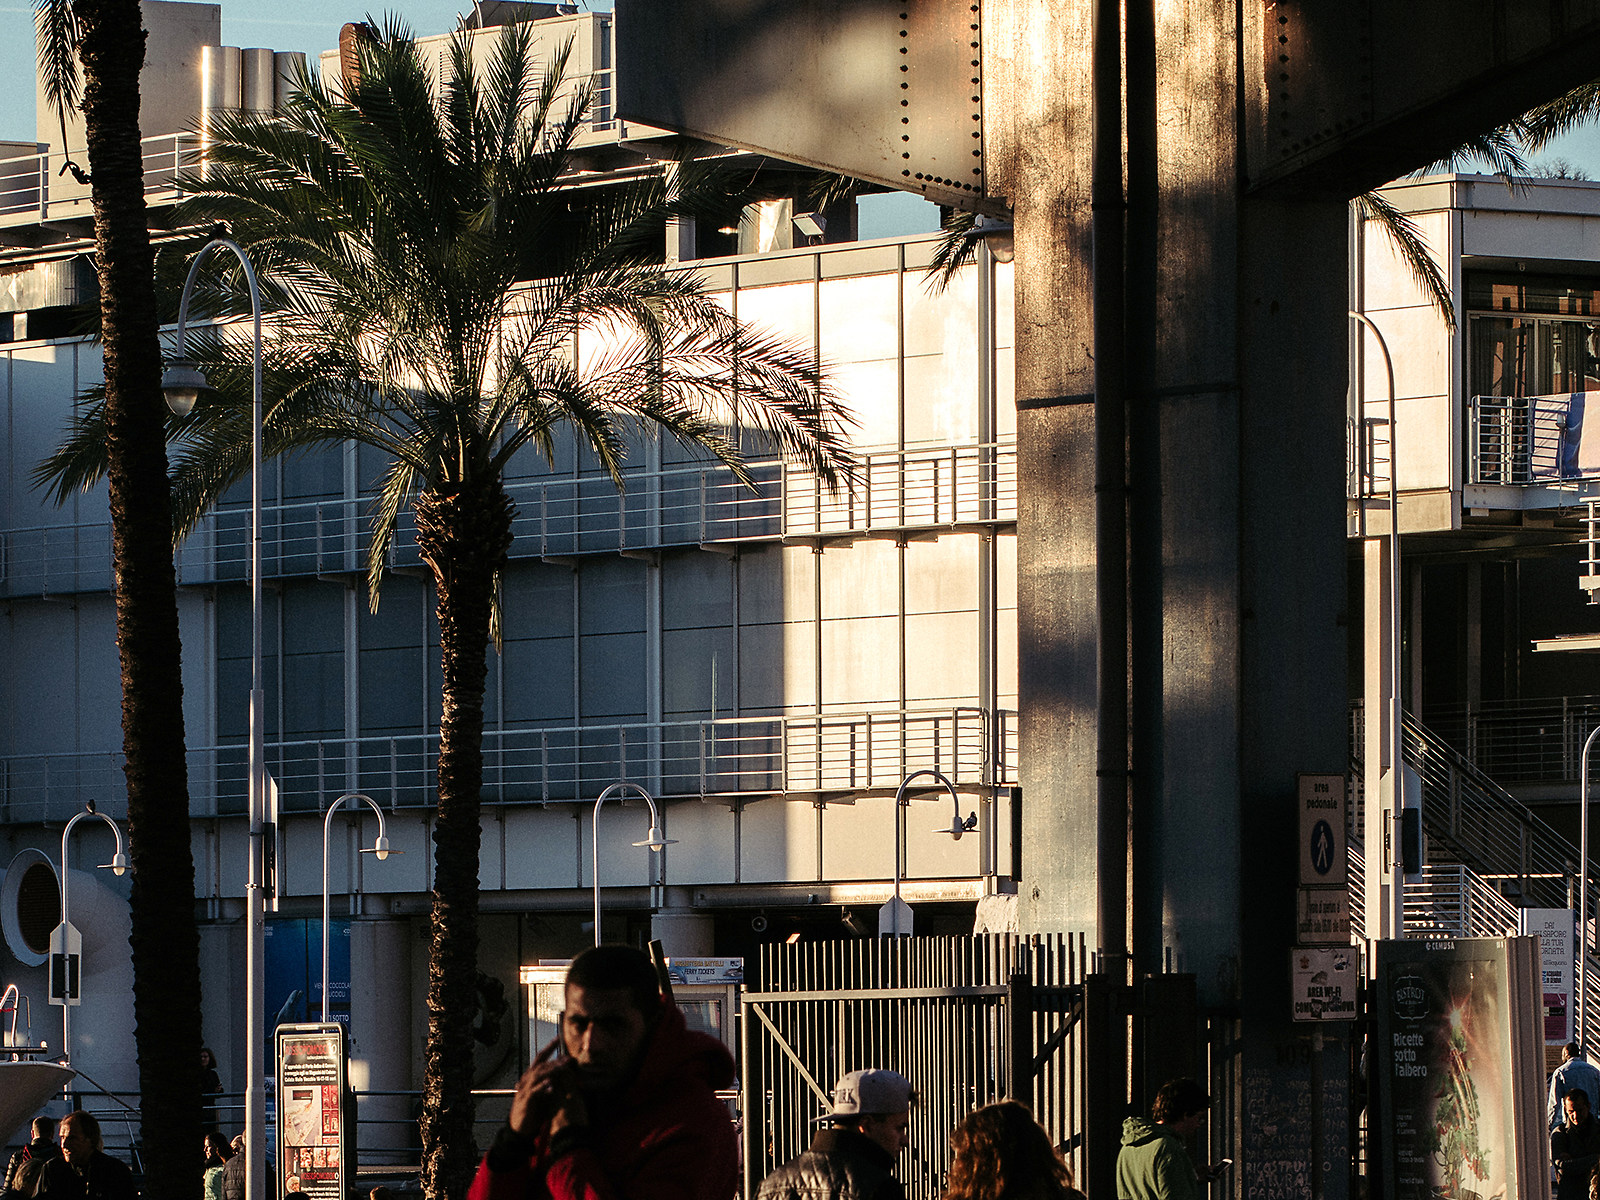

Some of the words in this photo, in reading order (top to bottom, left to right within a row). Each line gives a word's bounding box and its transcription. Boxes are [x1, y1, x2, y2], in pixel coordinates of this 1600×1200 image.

[1314, 783, 1329, 793] area
[1306, 796, 1338, 809] pedonale
[1543, 930, 1567, 938] SAPORE
[1551, 938, 1564, 946] TUA
[1541, 947, 1565, 955] ORNATA
[1307, 986, 1323, 997] AREA
[1395, 986, 1425, 1001] BISTROT
[1393, 1032, 1424, 1047] Ricette
[1395, 1049, 1417, 1062] sotto
[1395, 1063, 1428, 1078] l'albero
